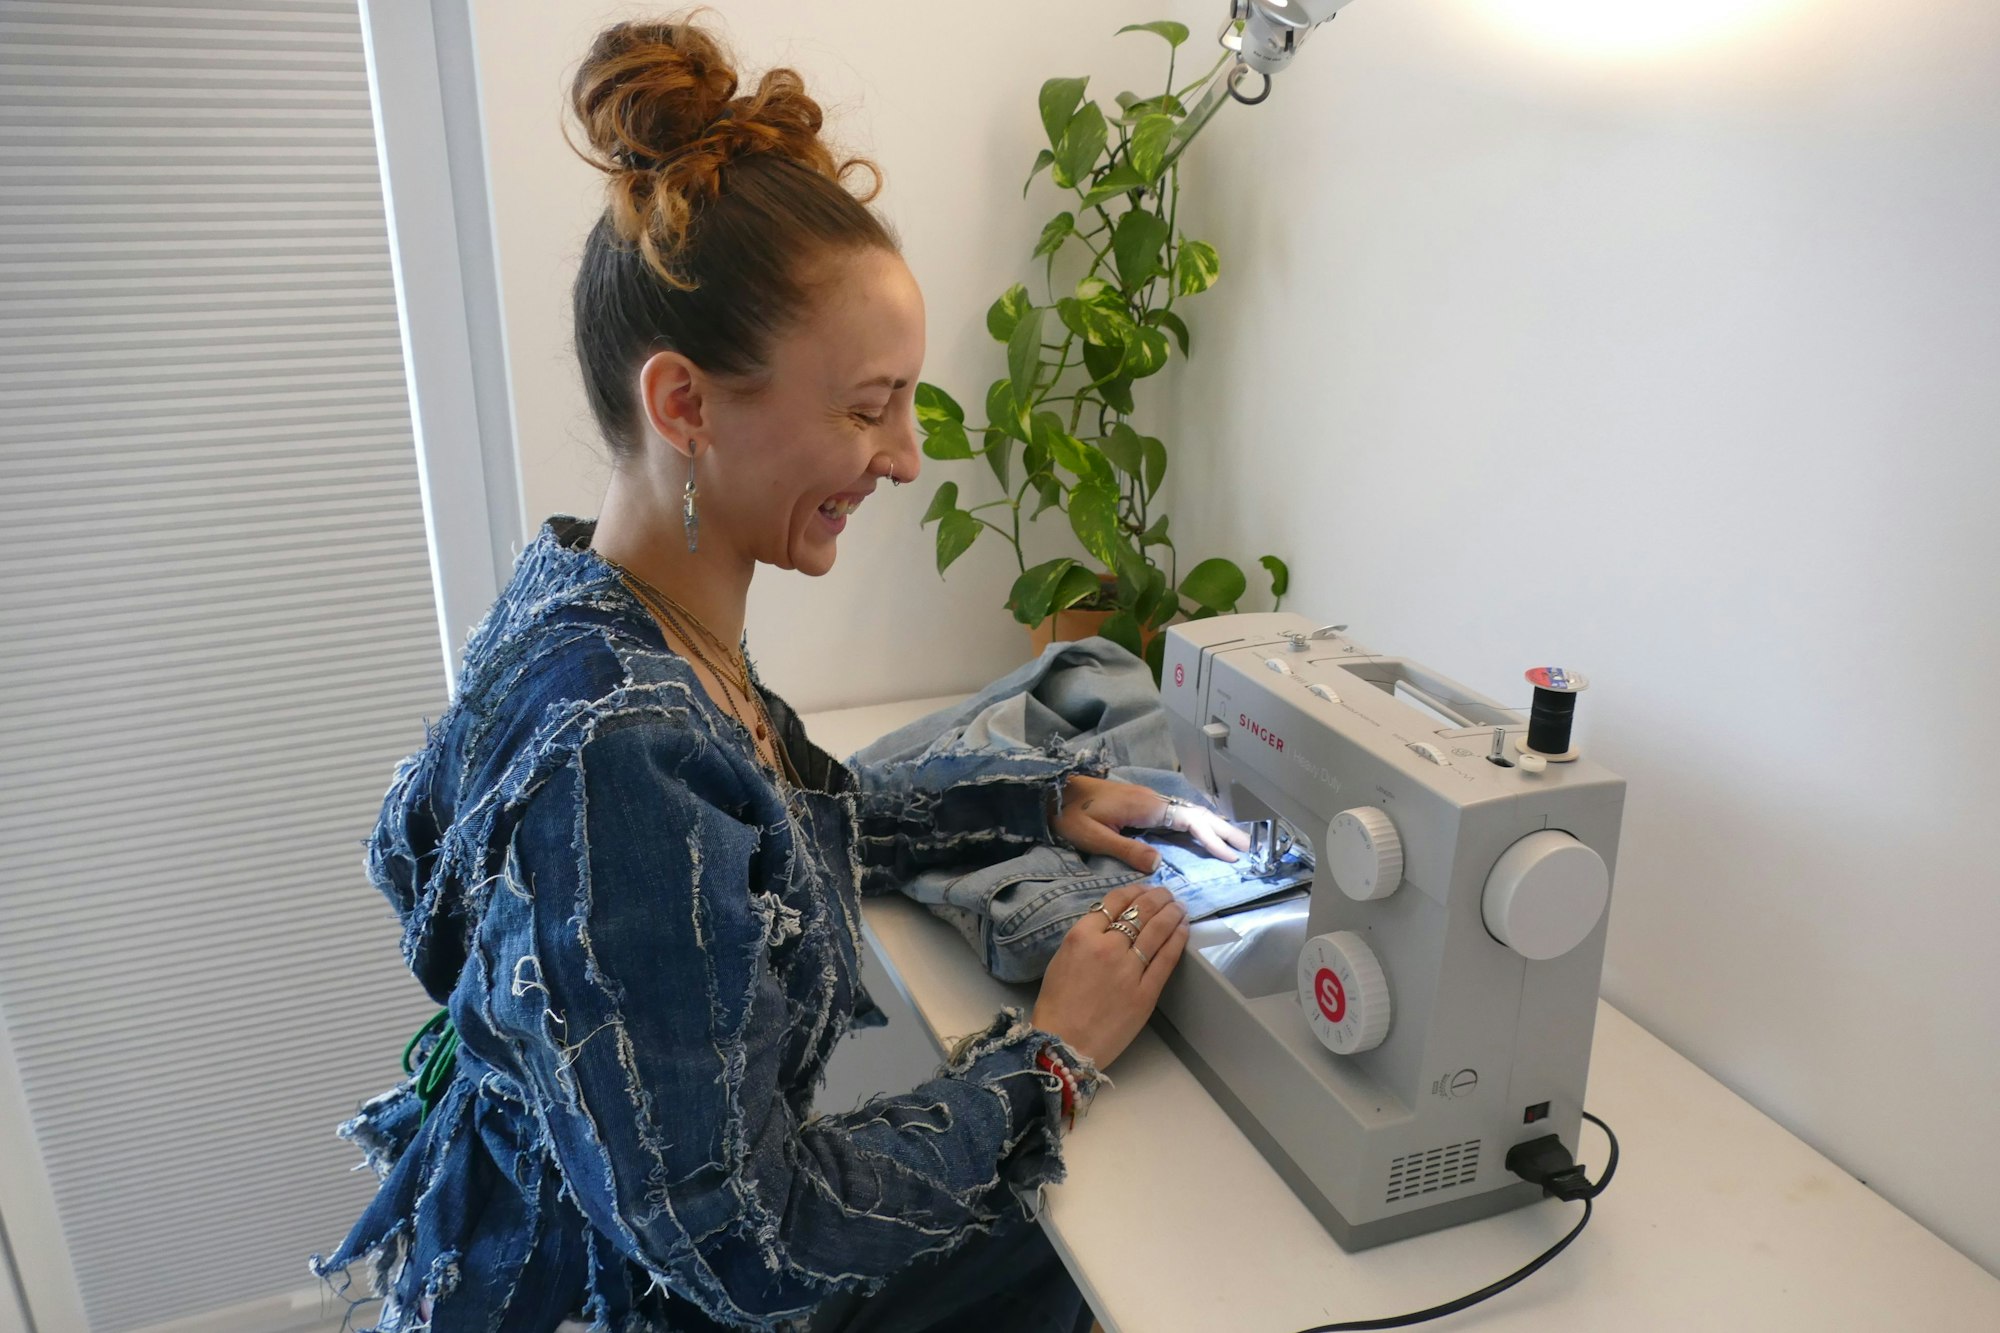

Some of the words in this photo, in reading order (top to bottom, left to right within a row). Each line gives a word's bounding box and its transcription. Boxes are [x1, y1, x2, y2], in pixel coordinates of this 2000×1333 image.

[1239, 713, 1284, 753] SINGER
[1293, 748, 1318, 779] Heavy
[1320, 768, 1342, 794] Duty
